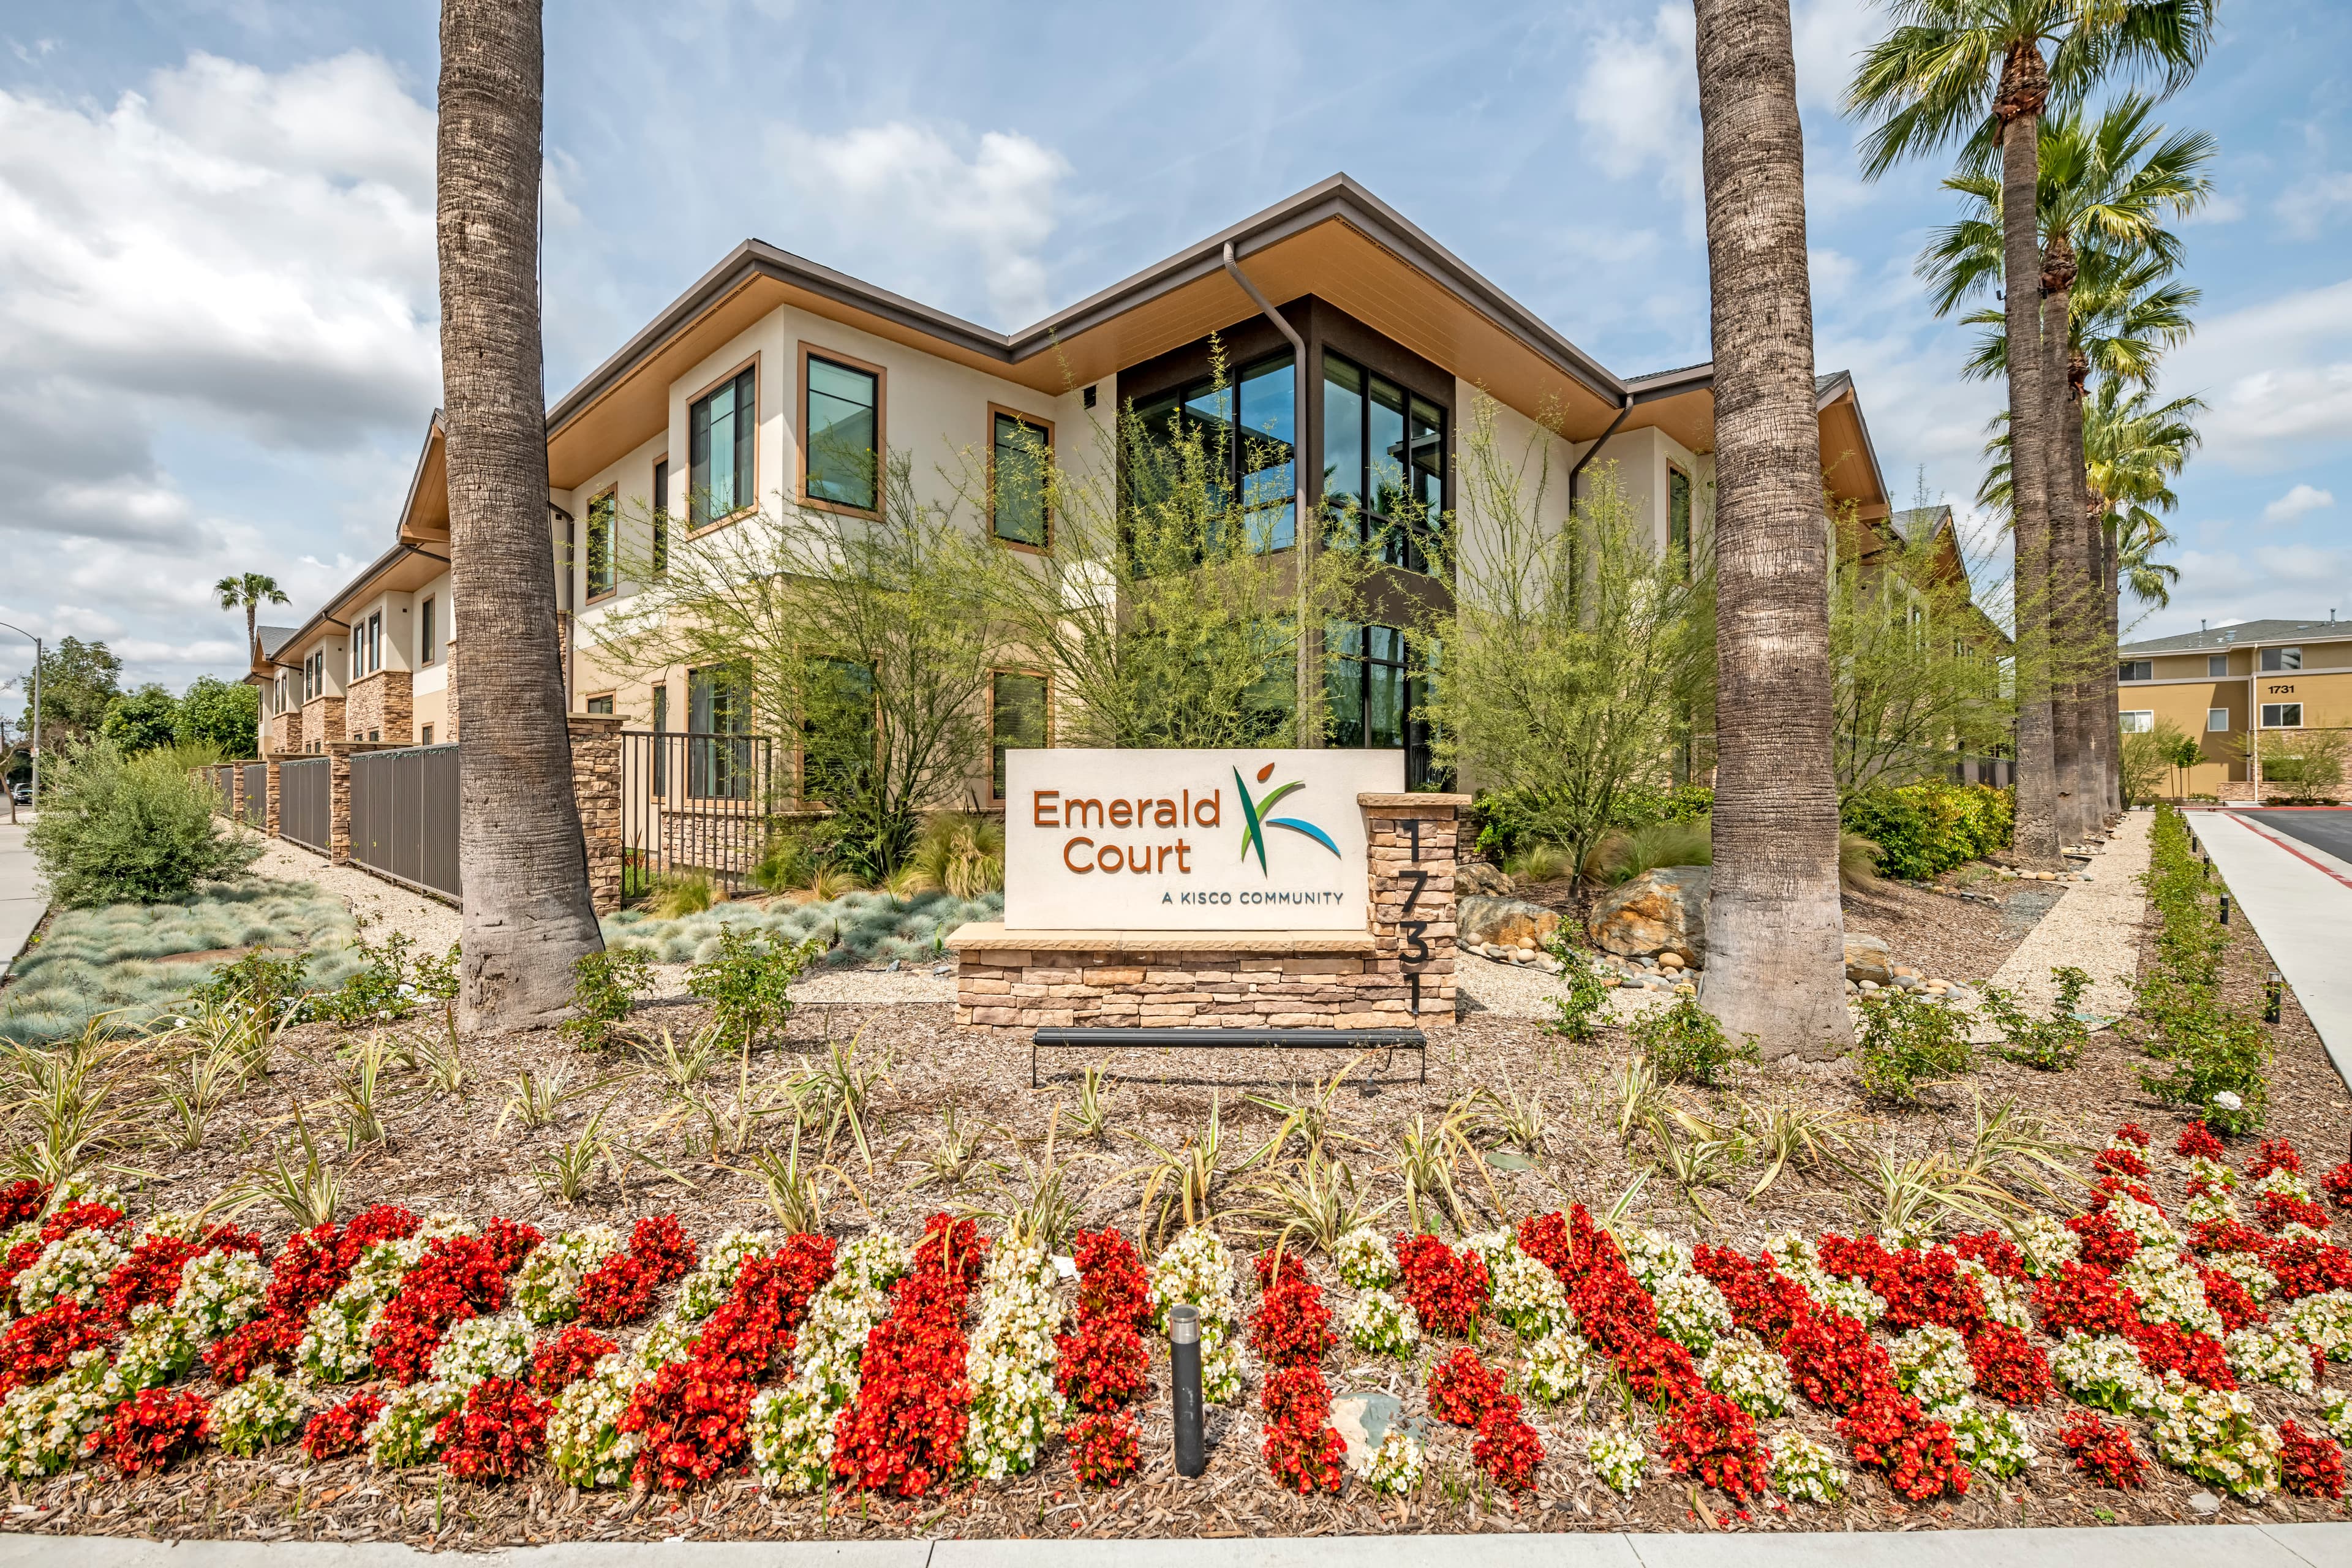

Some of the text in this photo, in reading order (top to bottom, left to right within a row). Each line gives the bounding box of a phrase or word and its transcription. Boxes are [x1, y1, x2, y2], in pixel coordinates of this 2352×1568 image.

[2268, 685, 2294, 694] 1731
[1033, 788, 1220, 826] Emerald
[1063, 836, 1191, 873] Court
[1162, 892, 1344, 905] A KISCO COMMUNITY
[1398, 819, 1429, 1015] 1731
